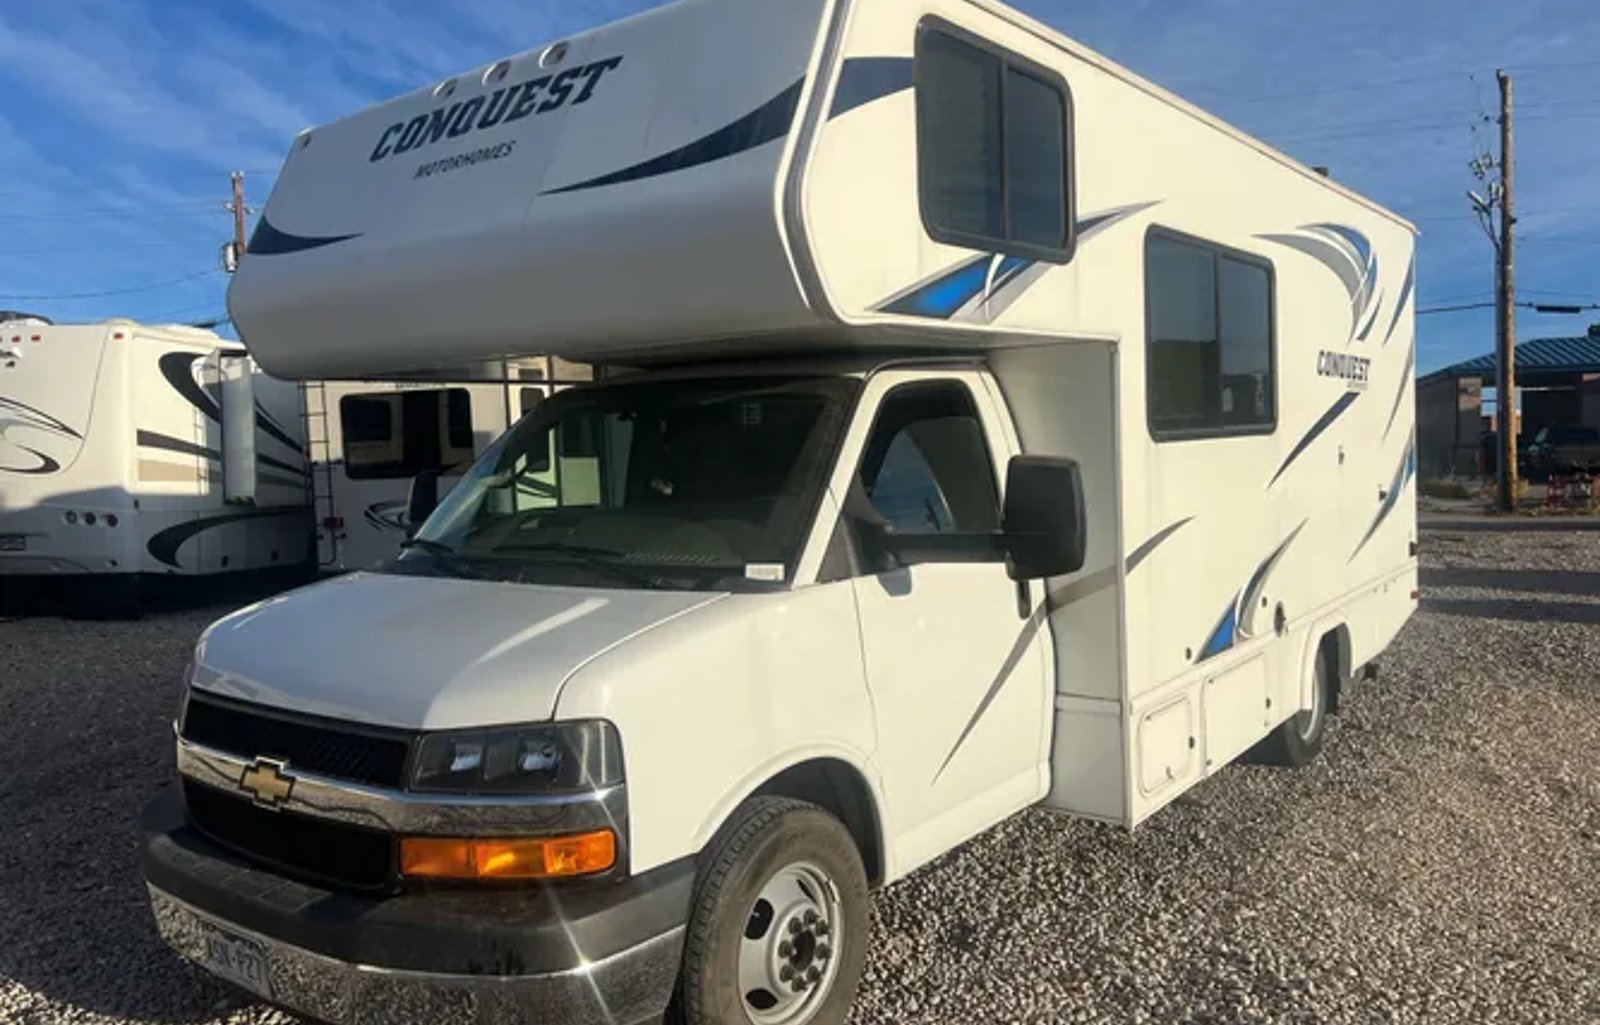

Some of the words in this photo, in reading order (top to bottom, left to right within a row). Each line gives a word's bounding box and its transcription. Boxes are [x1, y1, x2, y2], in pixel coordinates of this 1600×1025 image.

[369, 56, 624, 162] CONQUEST
[412, 141, 516, 179] MOTORHOMES
[1317, 350, 1371, 381] CONQUEST
